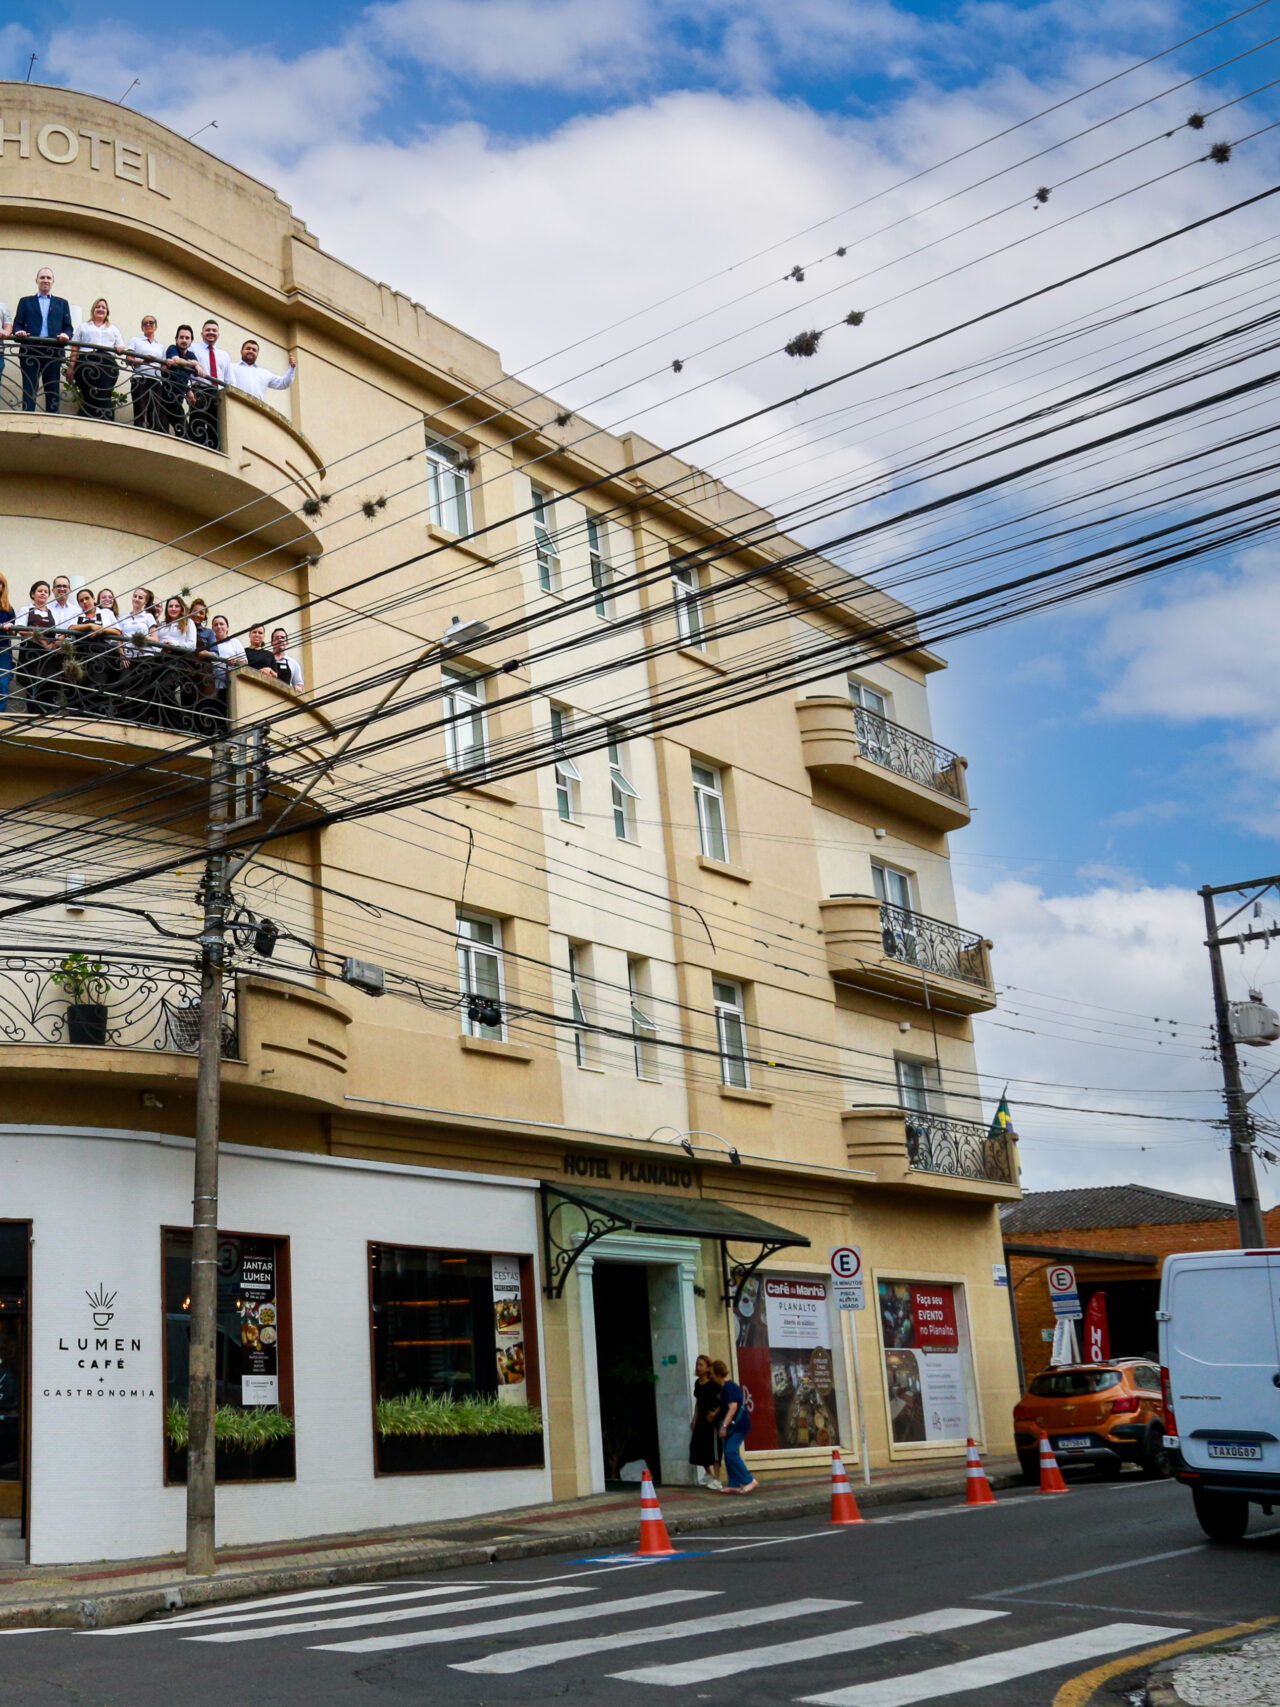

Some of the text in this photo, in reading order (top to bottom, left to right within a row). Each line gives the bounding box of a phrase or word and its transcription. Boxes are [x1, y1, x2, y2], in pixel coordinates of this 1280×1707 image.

[563, 1154, 693, 1189] HOTEL PLANALTO
[243, 1261, 273, 1271] JANTAR
[839, 1254, 851, 1272] E
[243, 1272, 271, 1282] LUMEN
[493, 1271, 519, 1281] CESTAS
[1056, 1272, 1068, 1287] E
[767, 1282, 790, 1295] Café
[916, 1294, 943, 1307] Faça seu
[778, 1302, 817, 1312] PLANALTO
[918, 1310, 944, 1321] EVENTO
[920, 1327, 928, 1335] no
[59, 1338, 141, 1351] LUMEN
[78, 1358, 125, 1369] CAFÉ
[43, 1389, 155, 1397] GASTRONOMIA
